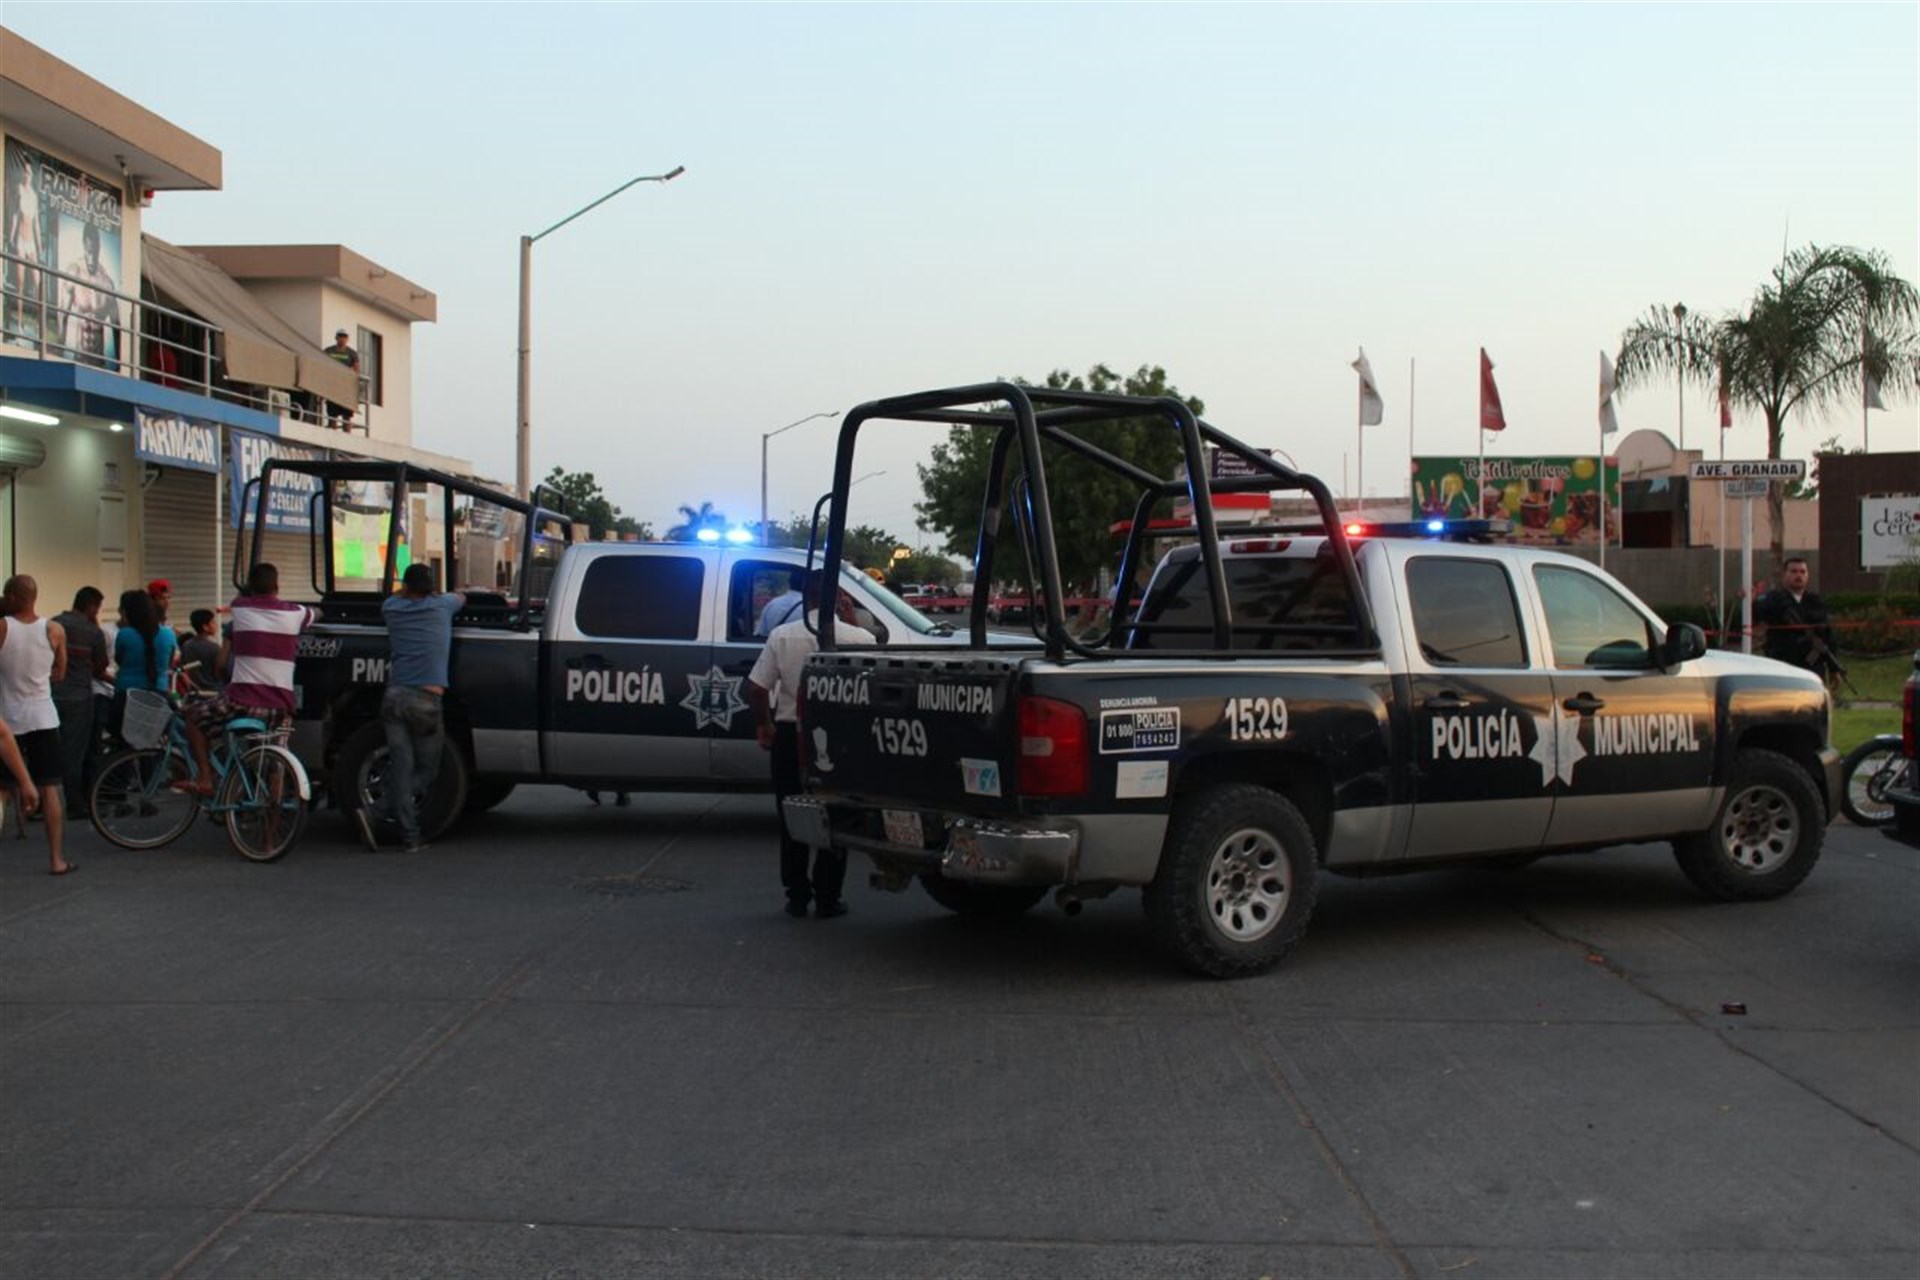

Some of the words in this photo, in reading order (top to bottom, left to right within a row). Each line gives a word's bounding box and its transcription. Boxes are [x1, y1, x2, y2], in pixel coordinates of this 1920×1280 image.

[138, 413, 216, 466] FARMACIA
[1696, 464, 1727, 476] AVE.
[1732, 464, 1799, 476] GRANADA
[566, 664, 665, 705] POLICÍA
[807, 672, 870, 705] POLICÍA
[872, 716, 928, 757] 1529
[1106, 725, 1117, 738] 01
[1118, 723, 1133, 738] 800
[1225, 697, 1288, 740] 1529
[1432, 708, 1522, 759] POLICÍA
[1595, 714, 1699, 756] MUNICIPAL
